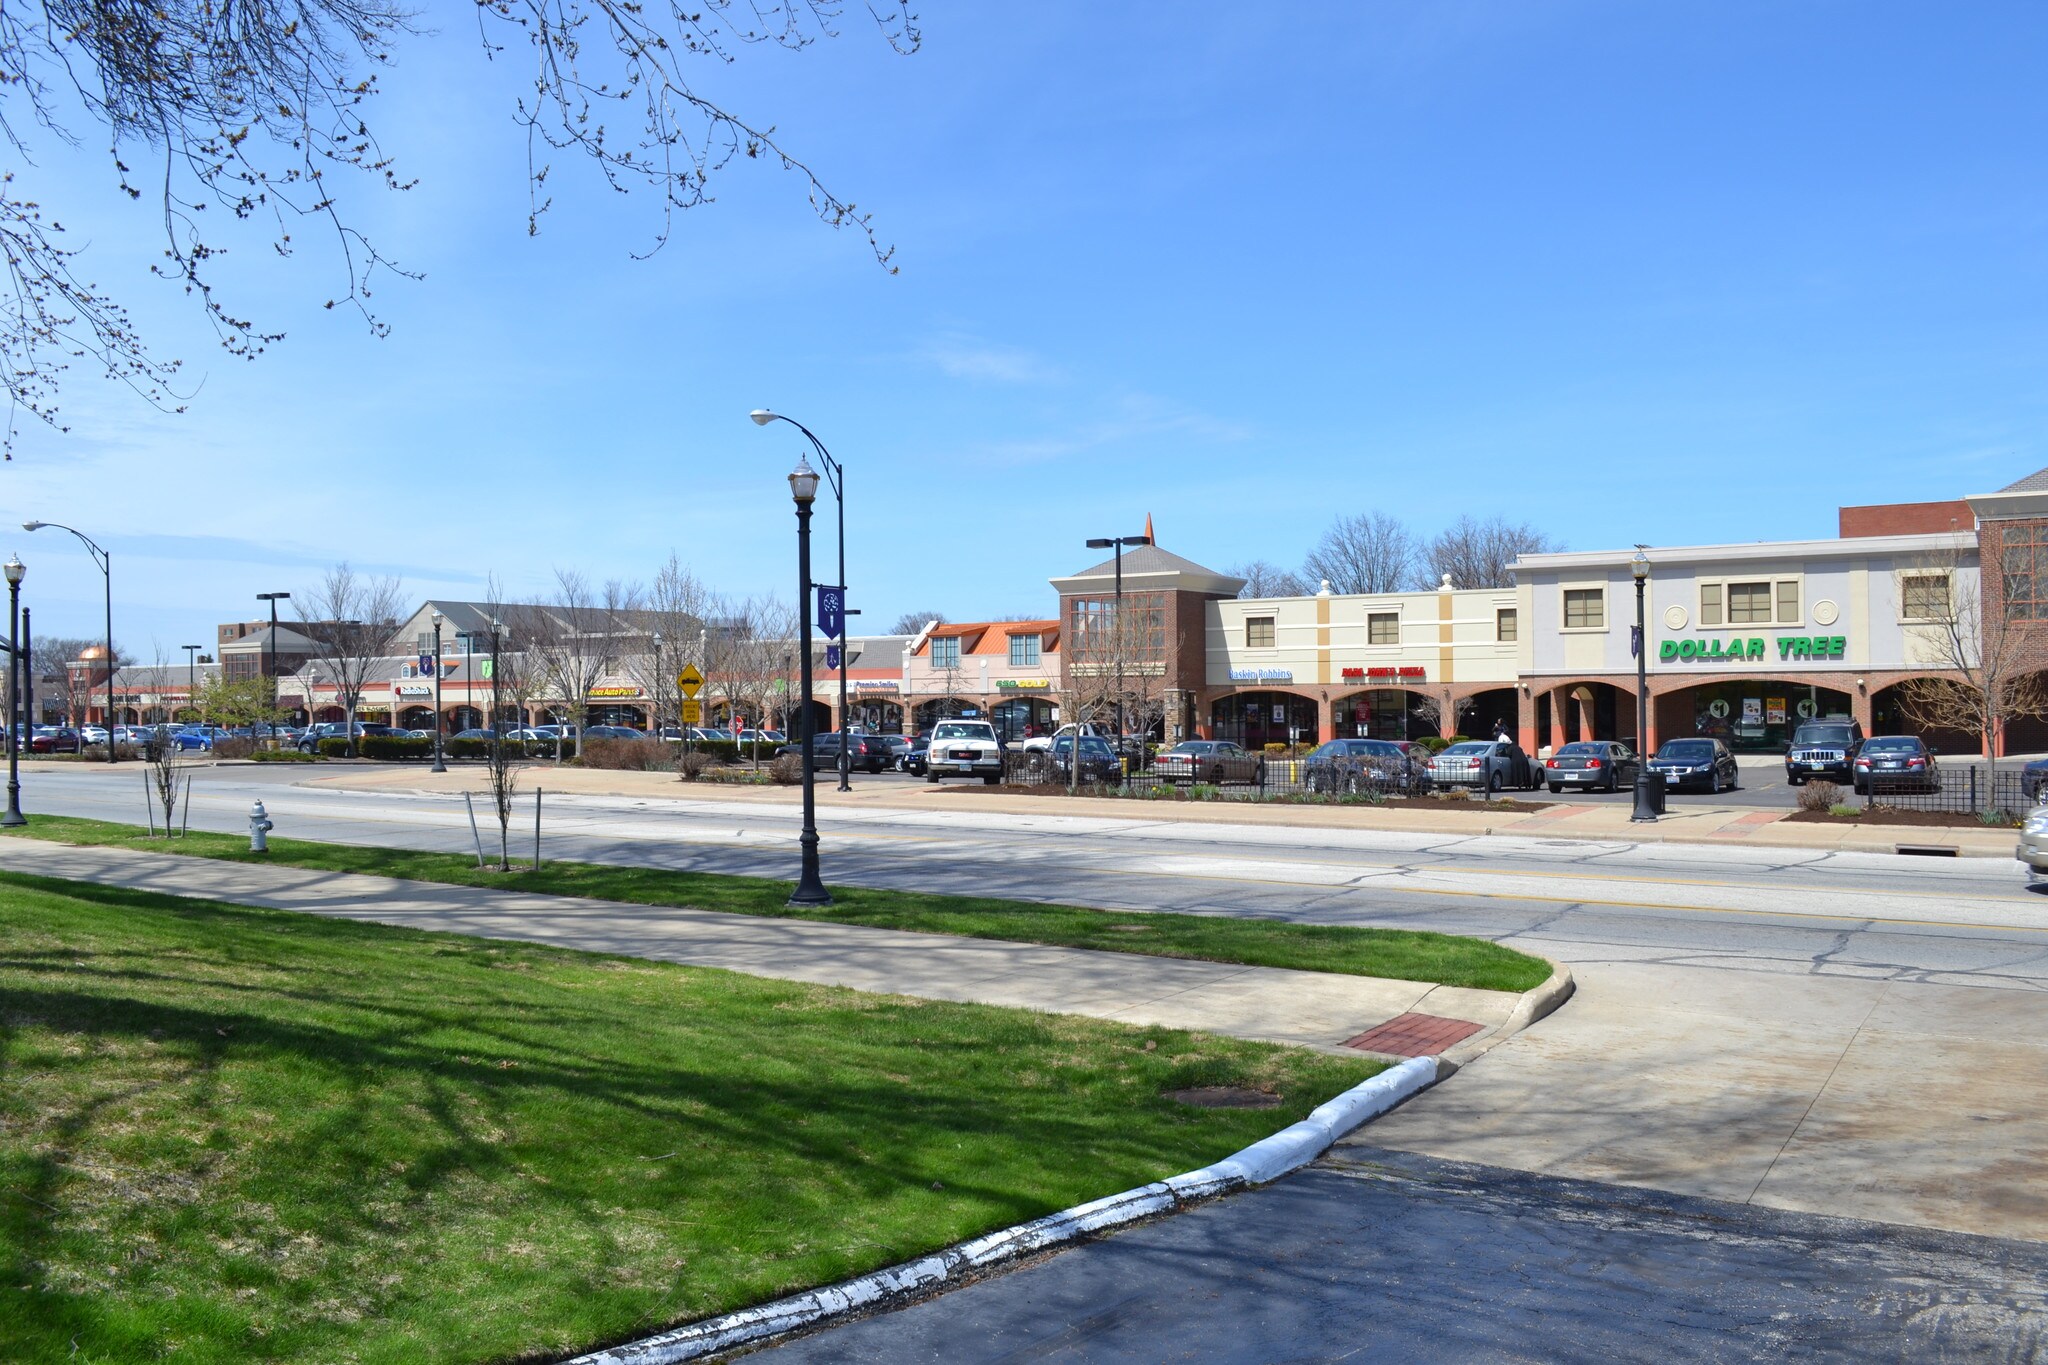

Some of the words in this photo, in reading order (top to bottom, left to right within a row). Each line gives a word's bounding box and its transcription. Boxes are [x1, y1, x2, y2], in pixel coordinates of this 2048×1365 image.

[1659, 637, 1765, 658] DOLLAR
[1776, 635, 1846, 656] TREE
[1229, 669, 1257, 679] Baskin
[1258, 668, 1291, 679] Robbins
[1018, 680, 1048, 688] GOLD
[401, 686, 430, 695] RadioShack
[604, 688, 619, 696] Auto
[619, 688, 635, 696] Parts
[1714, 703, 1724, 717] $1
[1801, 703, 1812, 717] $1
